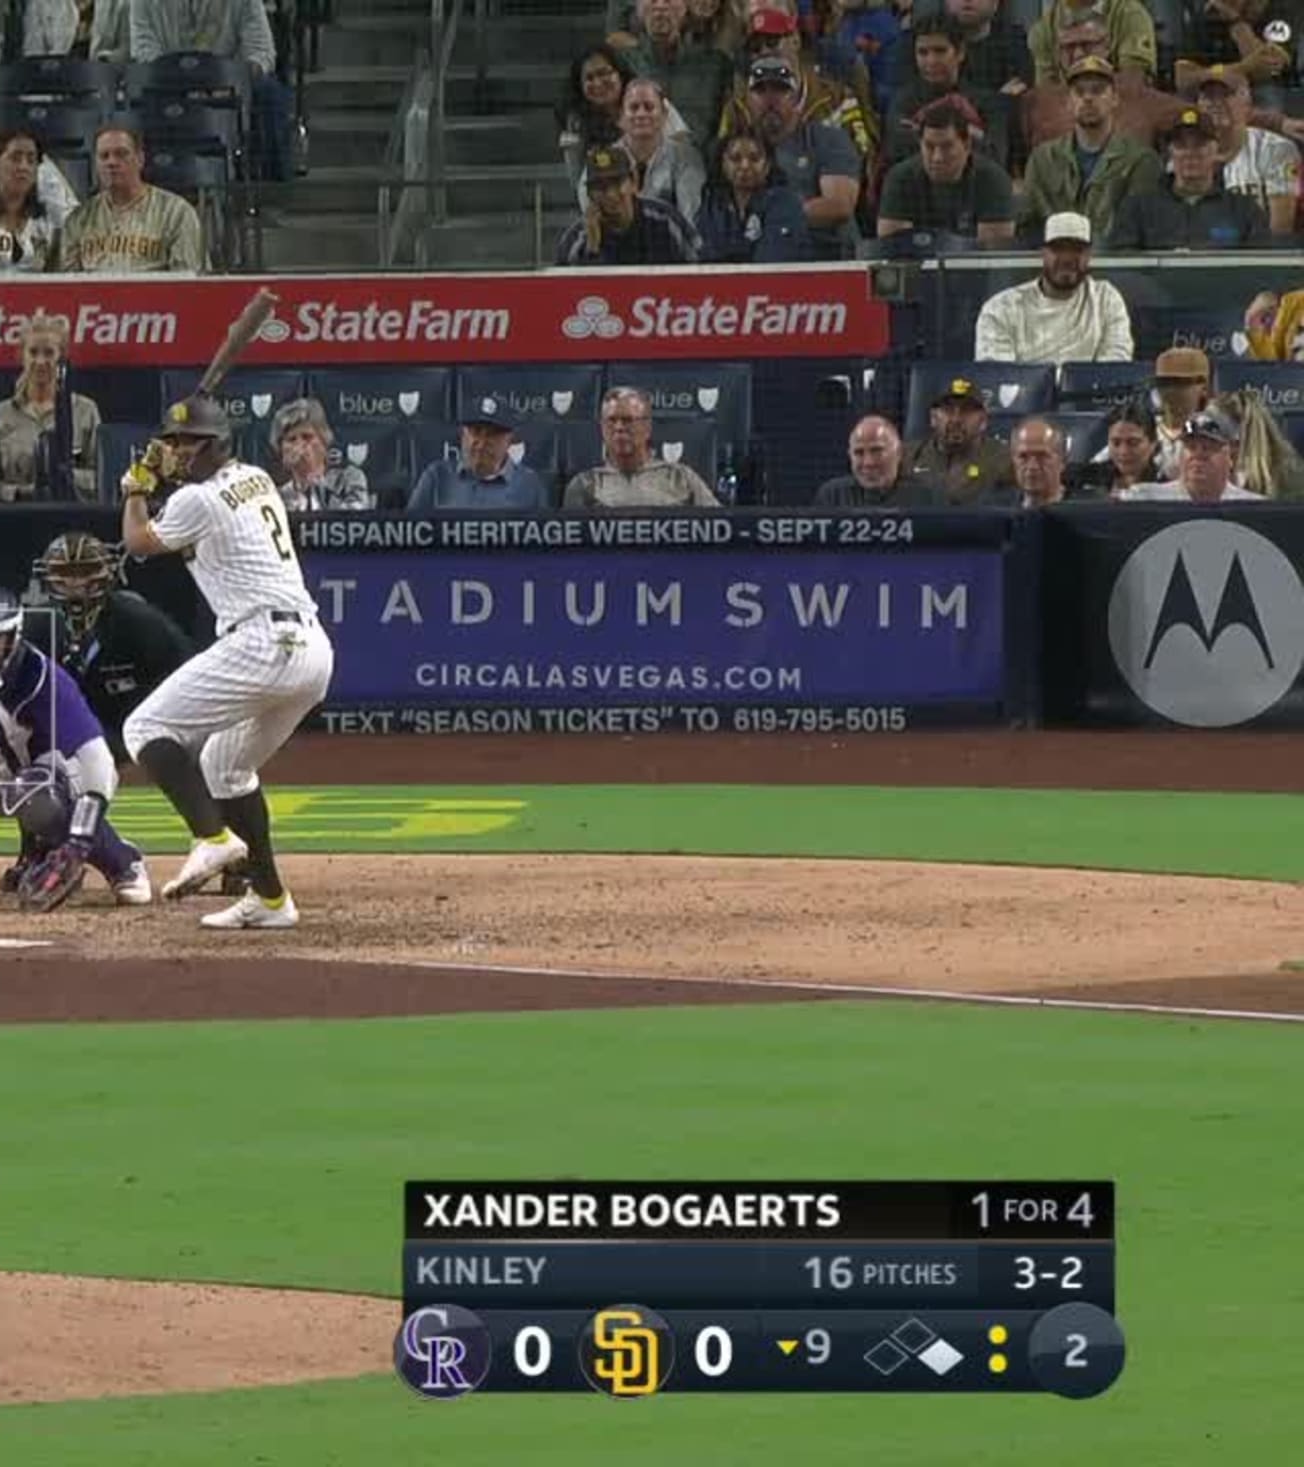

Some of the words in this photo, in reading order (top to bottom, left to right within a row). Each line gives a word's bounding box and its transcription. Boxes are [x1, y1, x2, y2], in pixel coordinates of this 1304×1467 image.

[339, 391, 393, 414] blue
[260, 505, 291, 562] 2
[300, 522, 433, 546] HISPANIC
[442, 521, 582, 545] HERITAGE
[590, 519, 732, 544] WEEKEND
[757, 518, 832, 543] SEPT
[838, 518, 914, 542] 22-24
[319, 580, 682, 626] TADIUM
[724, 581, 968, 629] SWIM
[415, 664, 802, 690] CIRCALASVEGAS.COM
[321, 711, 394, 734] TEXT
[680, 708, 719, 732] TO
[733, 707, 906, 732] 619-795-5015
